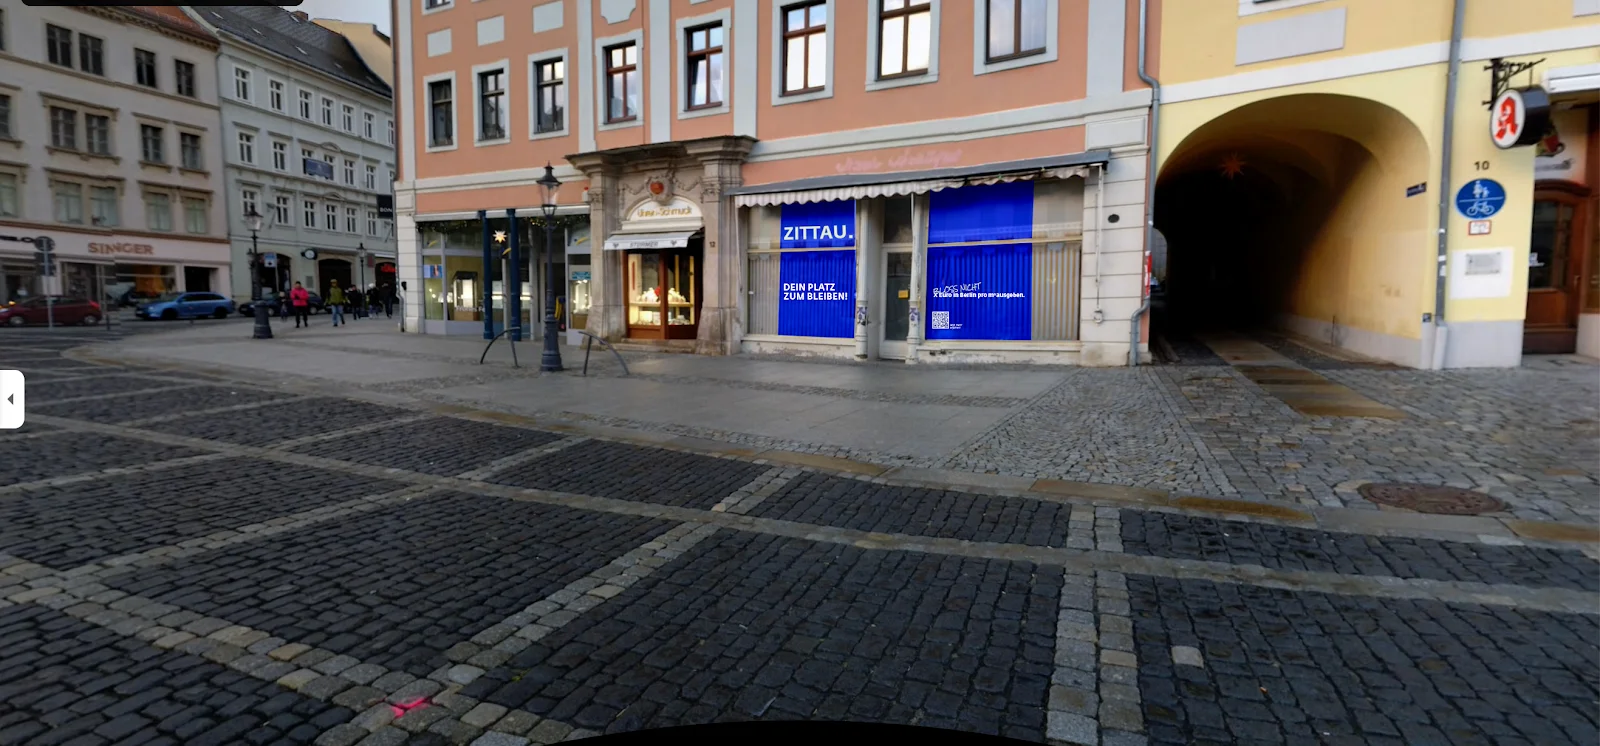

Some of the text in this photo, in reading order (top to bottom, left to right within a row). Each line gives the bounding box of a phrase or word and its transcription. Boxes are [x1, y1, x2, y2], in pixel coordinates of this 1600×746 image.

[1474, 161, 1490, 170] 10
[783, 225, 853, 240] ZITTAU.
[88, 242, 154, 255] SINGER
[783, 283, 835, 291] DEIN PLATZ
[932, 282, 982, 294] BLOSS NICHT
[783, 292, 848, 300] ZUM BLEIBEN!
